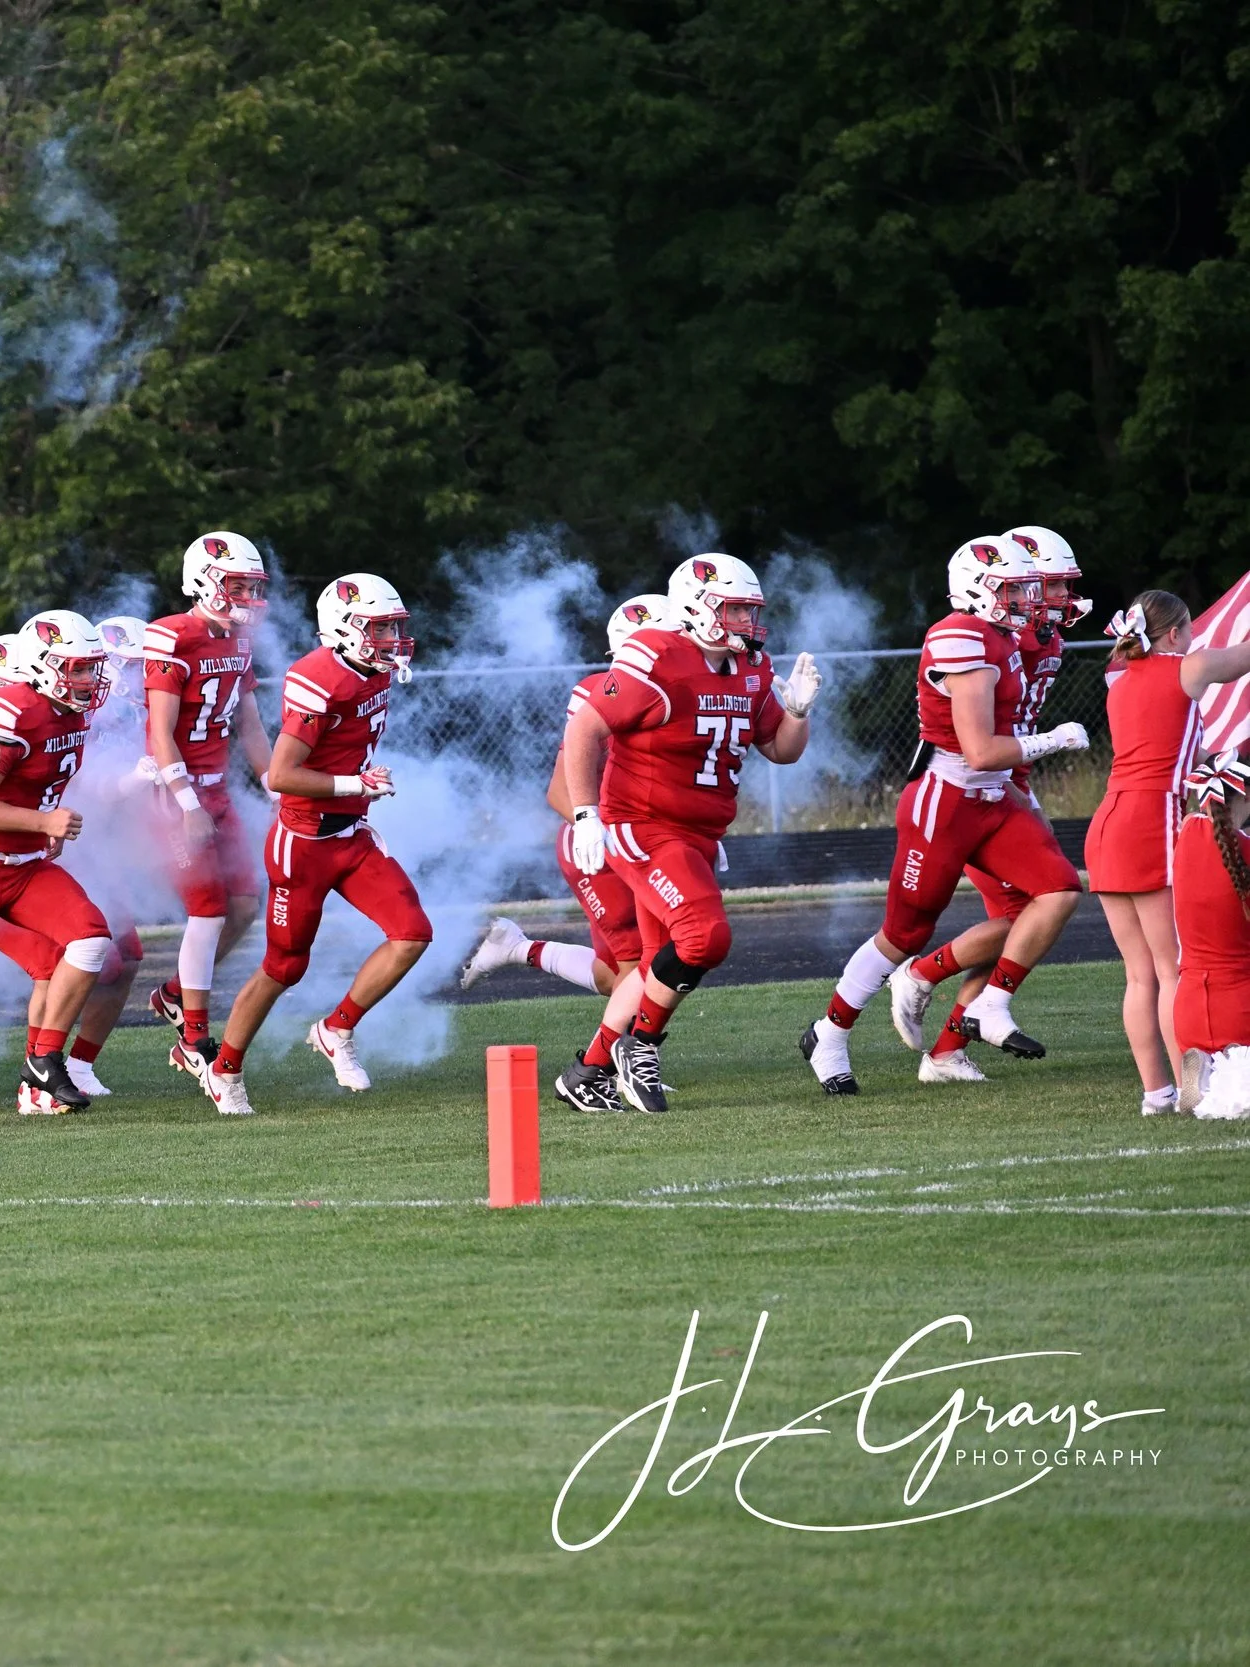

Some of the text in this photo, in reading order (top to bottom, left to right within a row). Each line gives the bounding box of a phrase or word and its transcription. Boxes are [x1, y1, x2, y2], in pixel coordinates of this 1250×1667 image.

[189, 676, 242, 741] 14
[698, 695, 752, 712] MILLINGTON
[360, 709, 386, 773] 7
[695, 715, 751, 787] 75
[38, 752, 77, 813] 2
[648, 868, 685, 909] CARDS
[902, 849, 924, 892] CARDS
[273, 886, 290, 927] CARDS
[577, 877, 606, 920] CARDS
